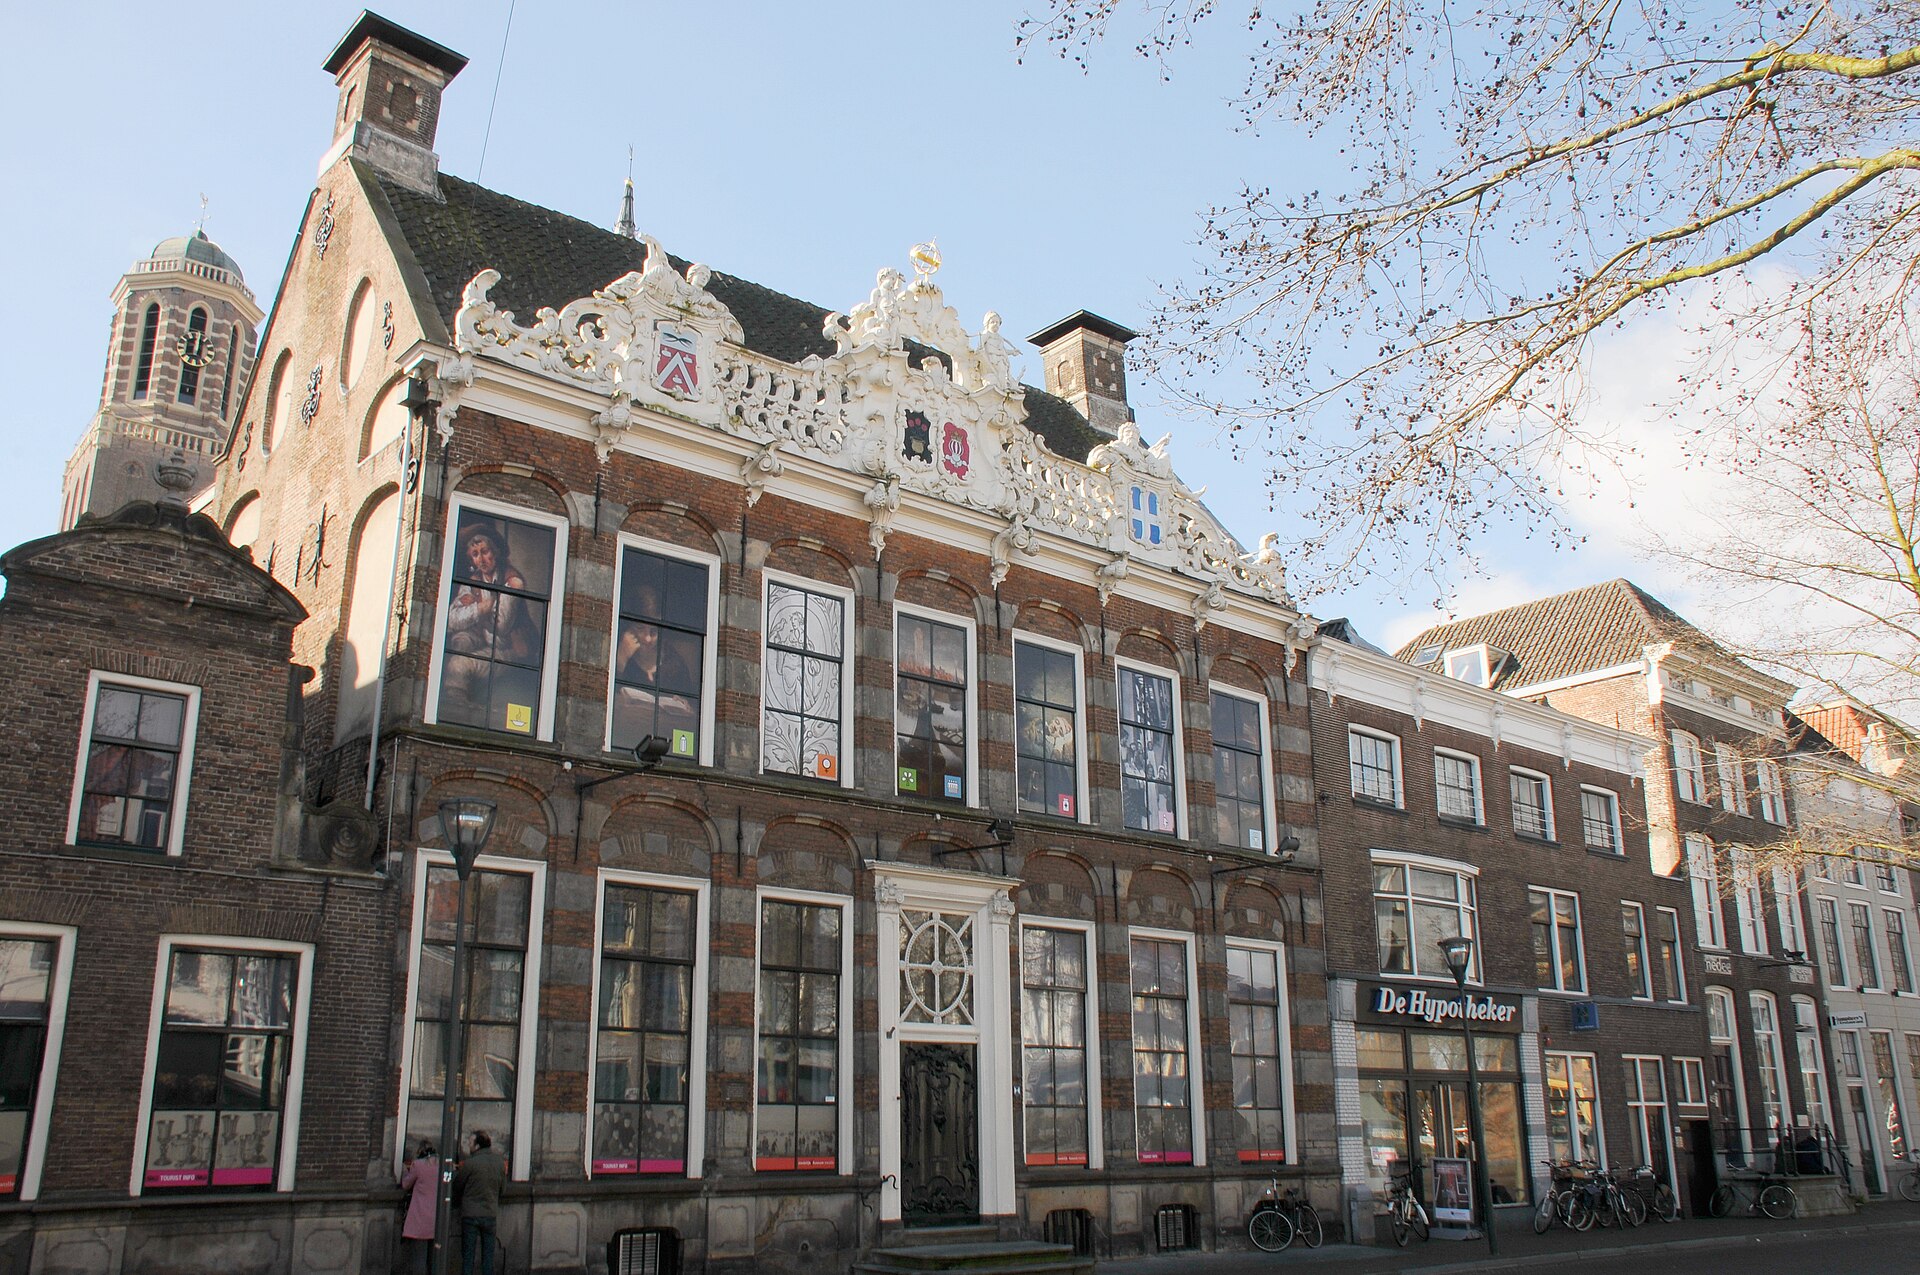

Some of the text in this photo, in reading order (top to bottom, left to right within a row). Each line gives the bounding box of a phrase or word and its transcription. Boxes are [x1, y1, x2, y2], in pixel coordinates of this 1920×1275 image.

[1377, 987, 1517, 1024] De Hypotheker
[160, 1174, 182, 1182] TOURIST
